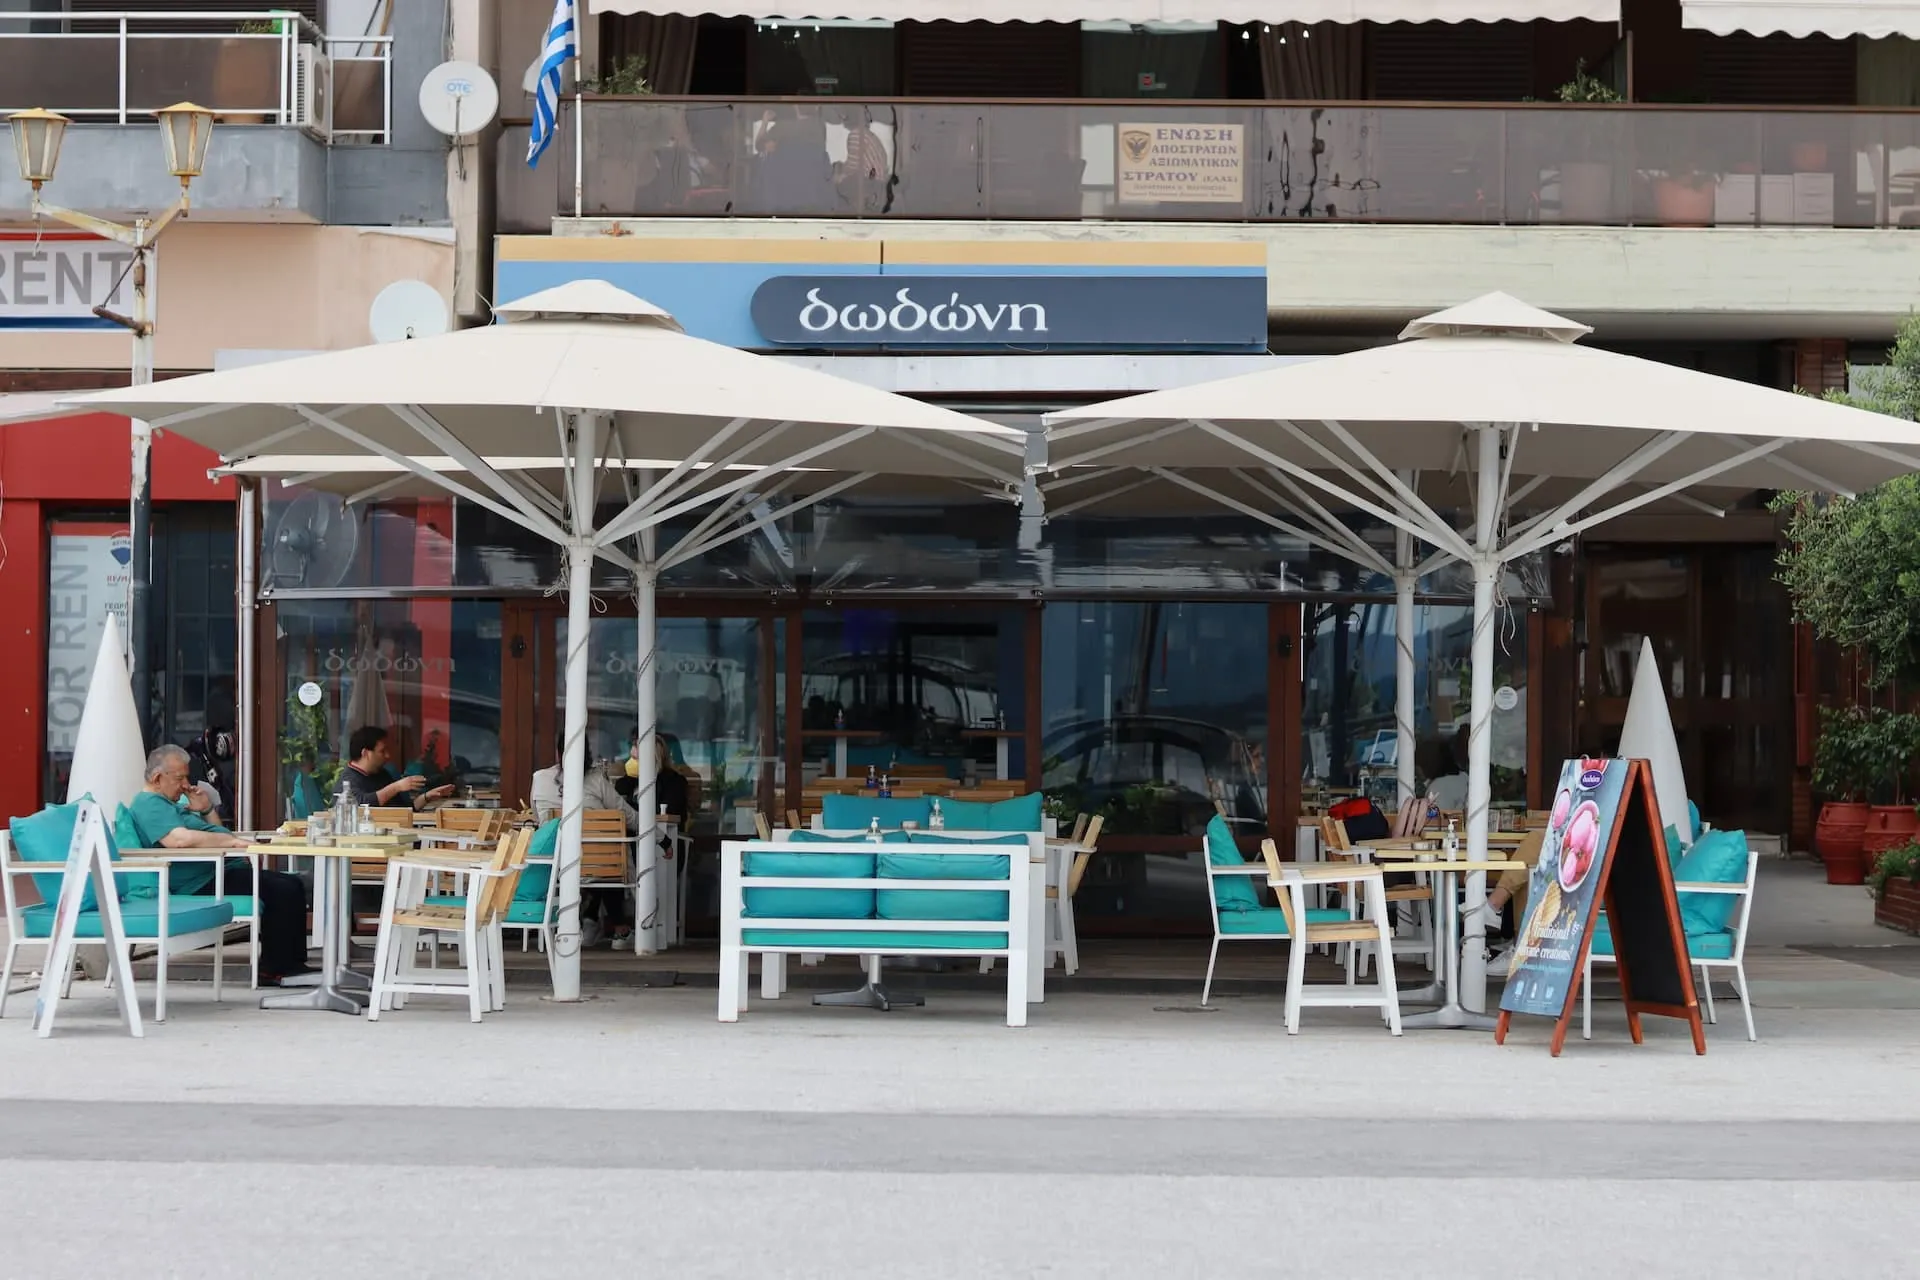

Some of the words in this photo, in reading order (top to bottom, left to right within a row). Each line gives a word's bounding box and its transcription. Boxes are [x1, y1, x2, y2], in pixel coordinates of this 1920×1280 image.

[1156, 128, 1233, 141] ΕΝΩΣΗ
[1151, 144, 1238, 155] ΑΠΟΣΤΡΑΤΩΝ
[1149, 157, 1240, 168] ΑΞΙΩΜΑΤΙΚΩΝ
[1123, 171, 1199, 182] ΣΤΡΑΤΟΥ
[0, 251, 134, 306] ENT
[799, 287, 1049, 332] δωδώνη
[52, 535, 88, 650] RENT
